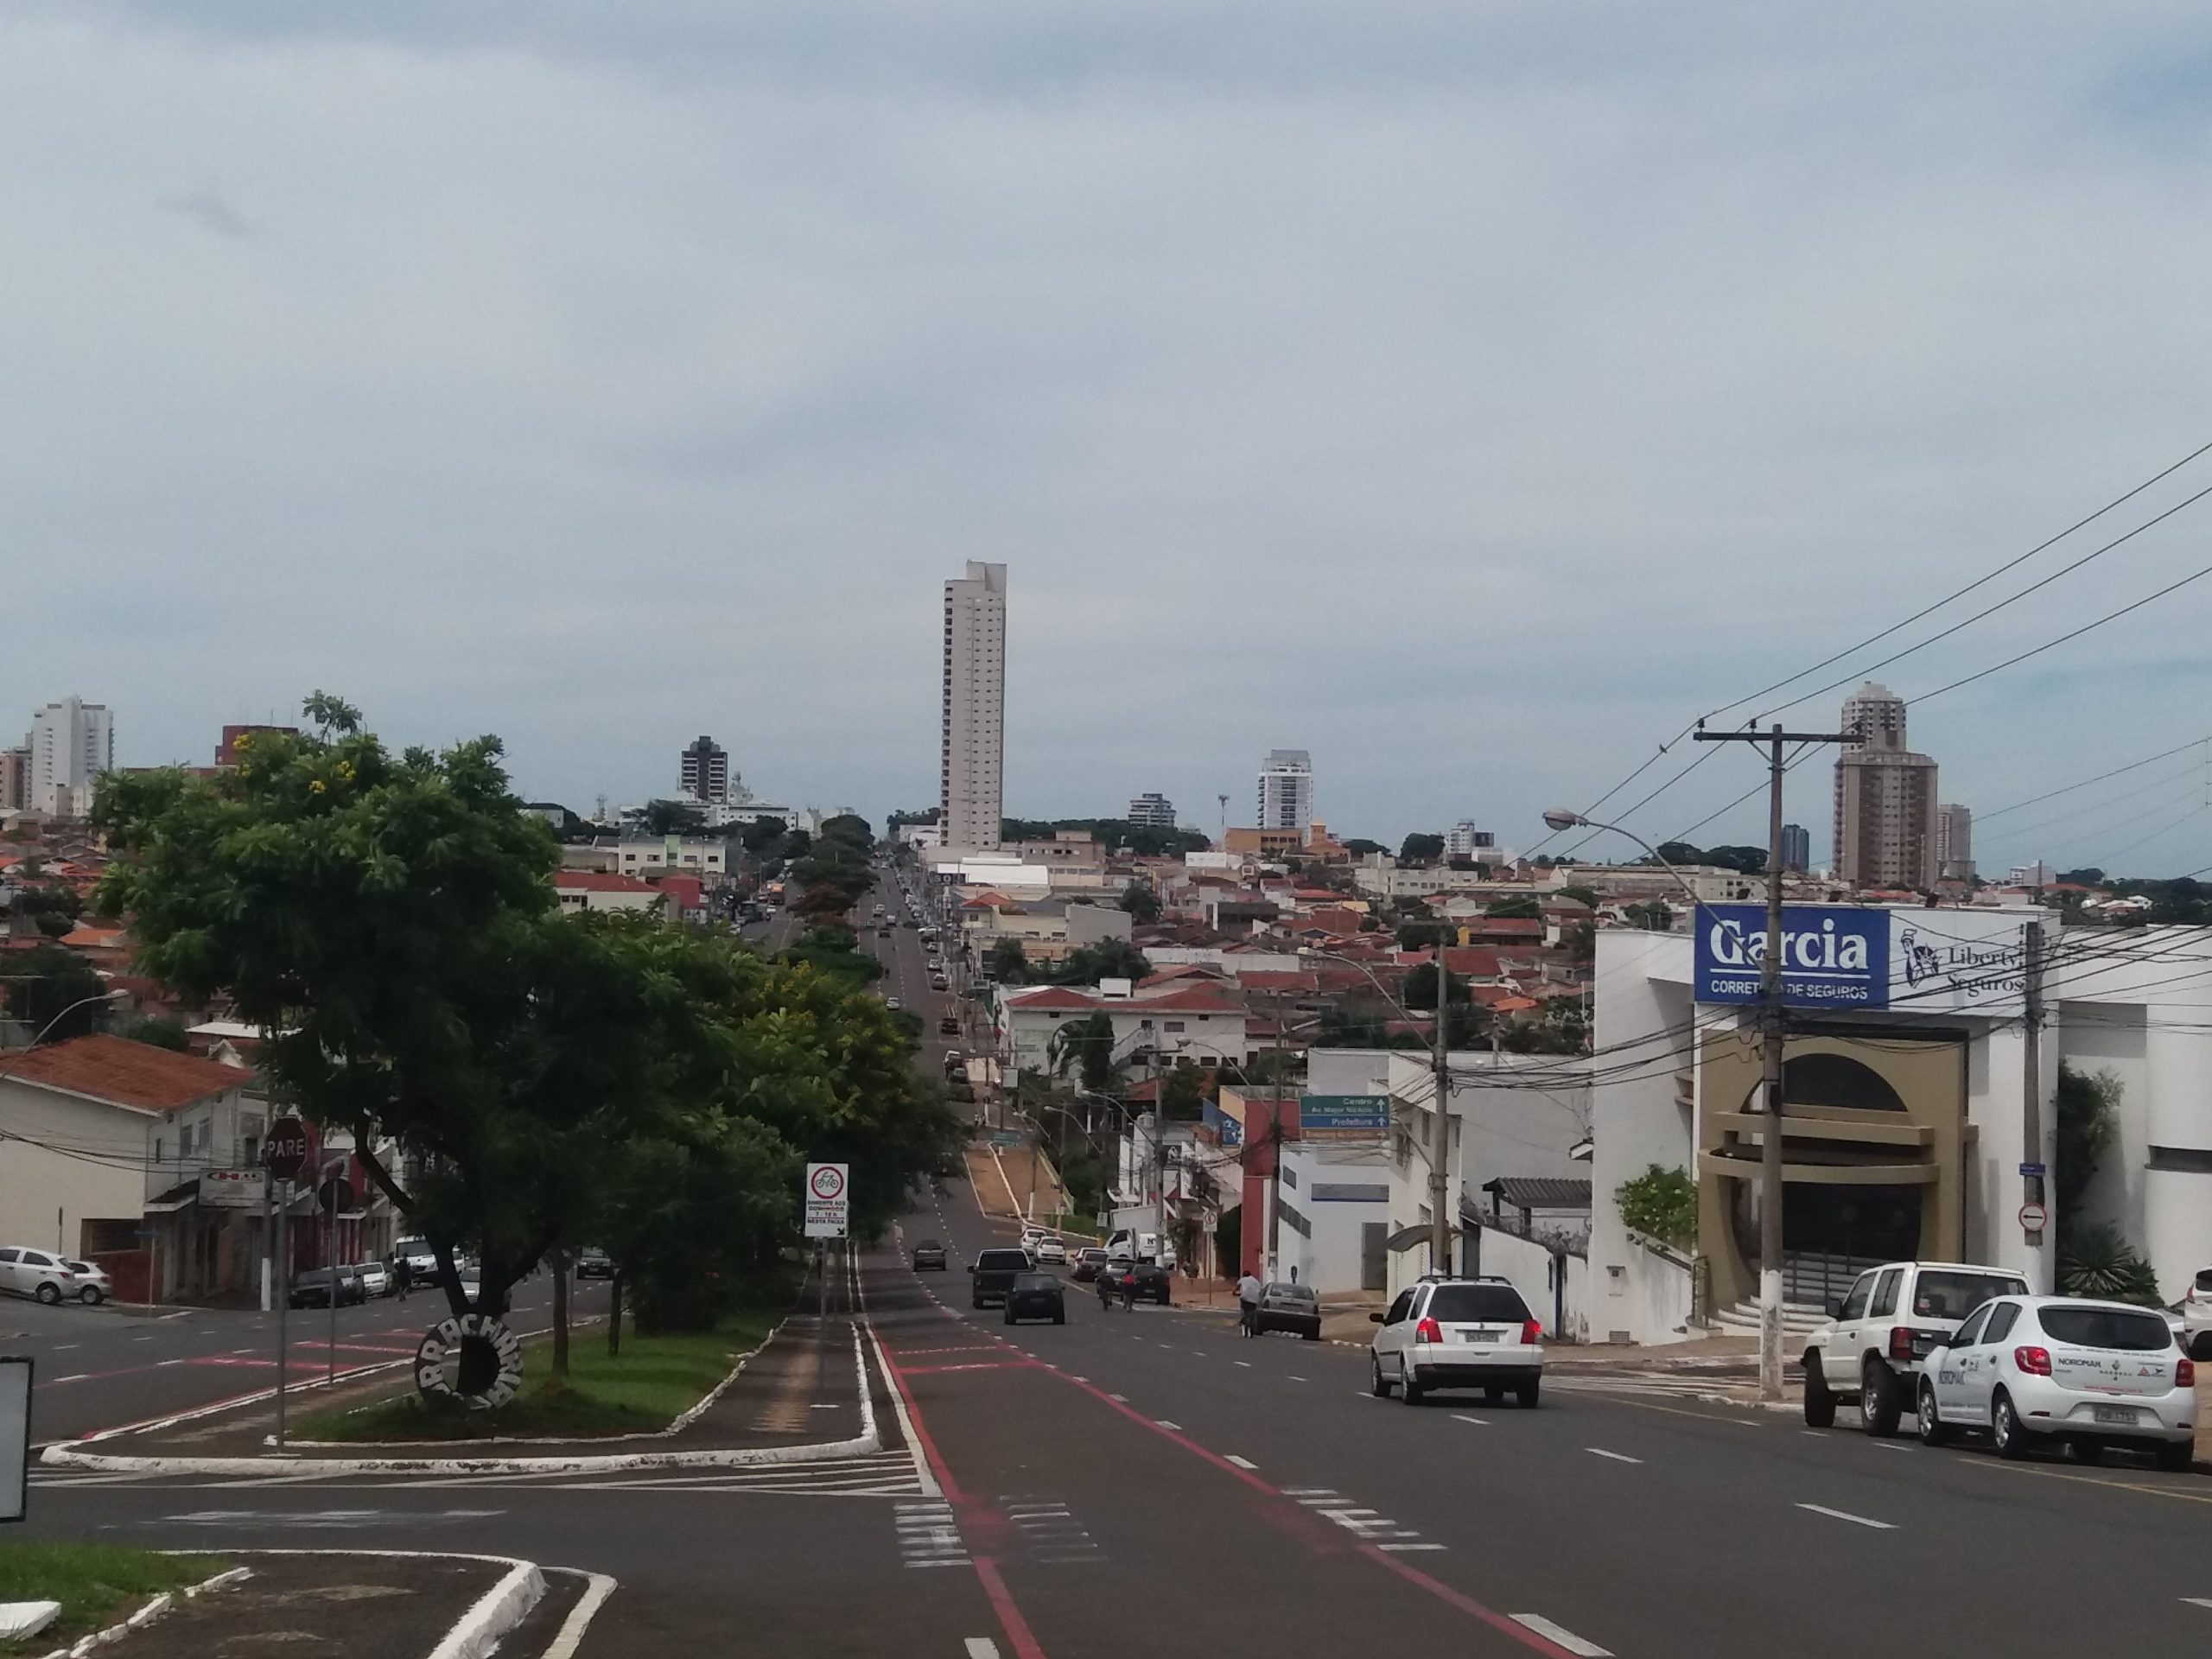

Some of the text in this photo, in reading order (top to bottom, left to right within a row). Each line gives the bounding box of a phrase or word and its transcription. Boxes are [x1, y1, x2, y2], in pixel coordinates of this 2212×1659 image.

[1710, 918, 1869, 969] Garcia
[1948, 946, 2018, 969] Liberty
[1806, 983, 1868, 1000] SEGUROS
[267, 1138, 305, 1158] PARE
